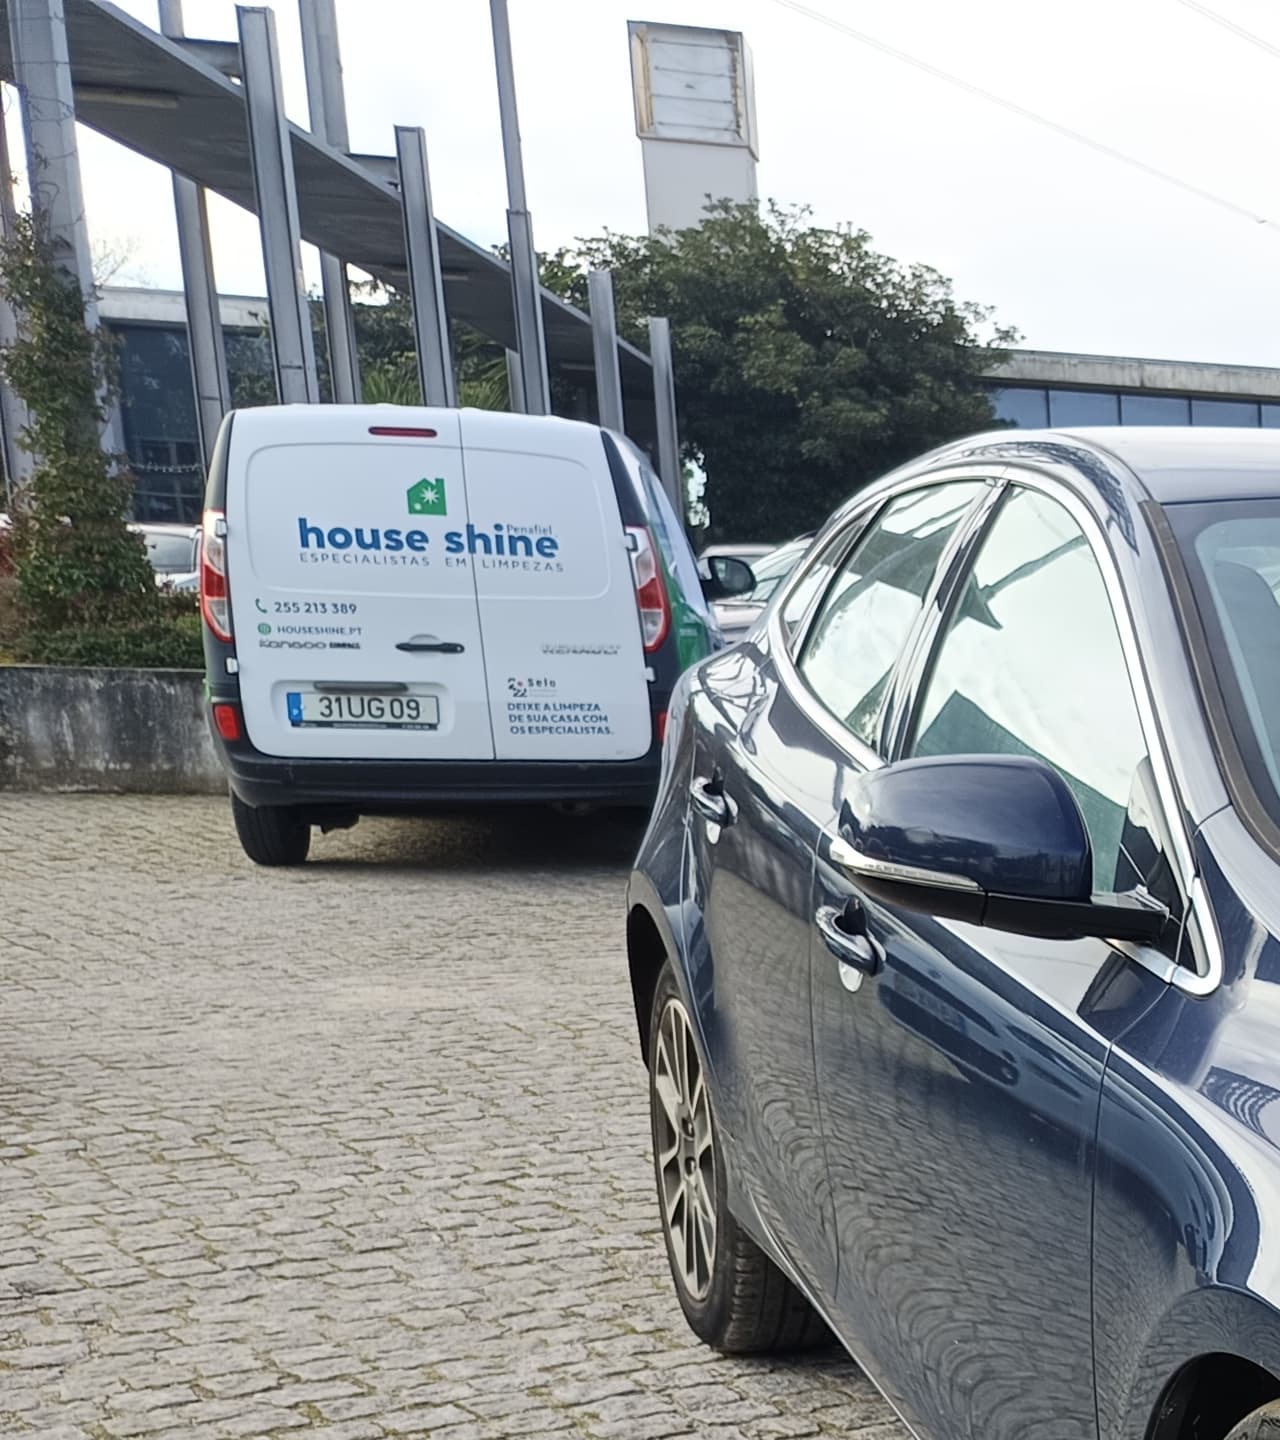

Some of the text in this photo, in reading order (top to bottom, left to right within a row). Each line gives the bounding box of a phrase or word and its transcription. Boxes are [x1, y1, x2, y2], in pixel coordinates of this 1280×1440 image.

[506, 524, 553, 535] Penafiel
[298, 517, 559, 559] house shine
[299, 552, 565, 573] ESPECIALISTAS EM LIMPEZAS
[274, 601, 358, 614] 255 213 389
[319, 695, 421, 720] 31UG09
[507, 702, 601, 712] DEIXE A LIMPEZA
[508, 714, 609, 724] DE SUA CASA COM
[510, 726, 526, 735] OS
